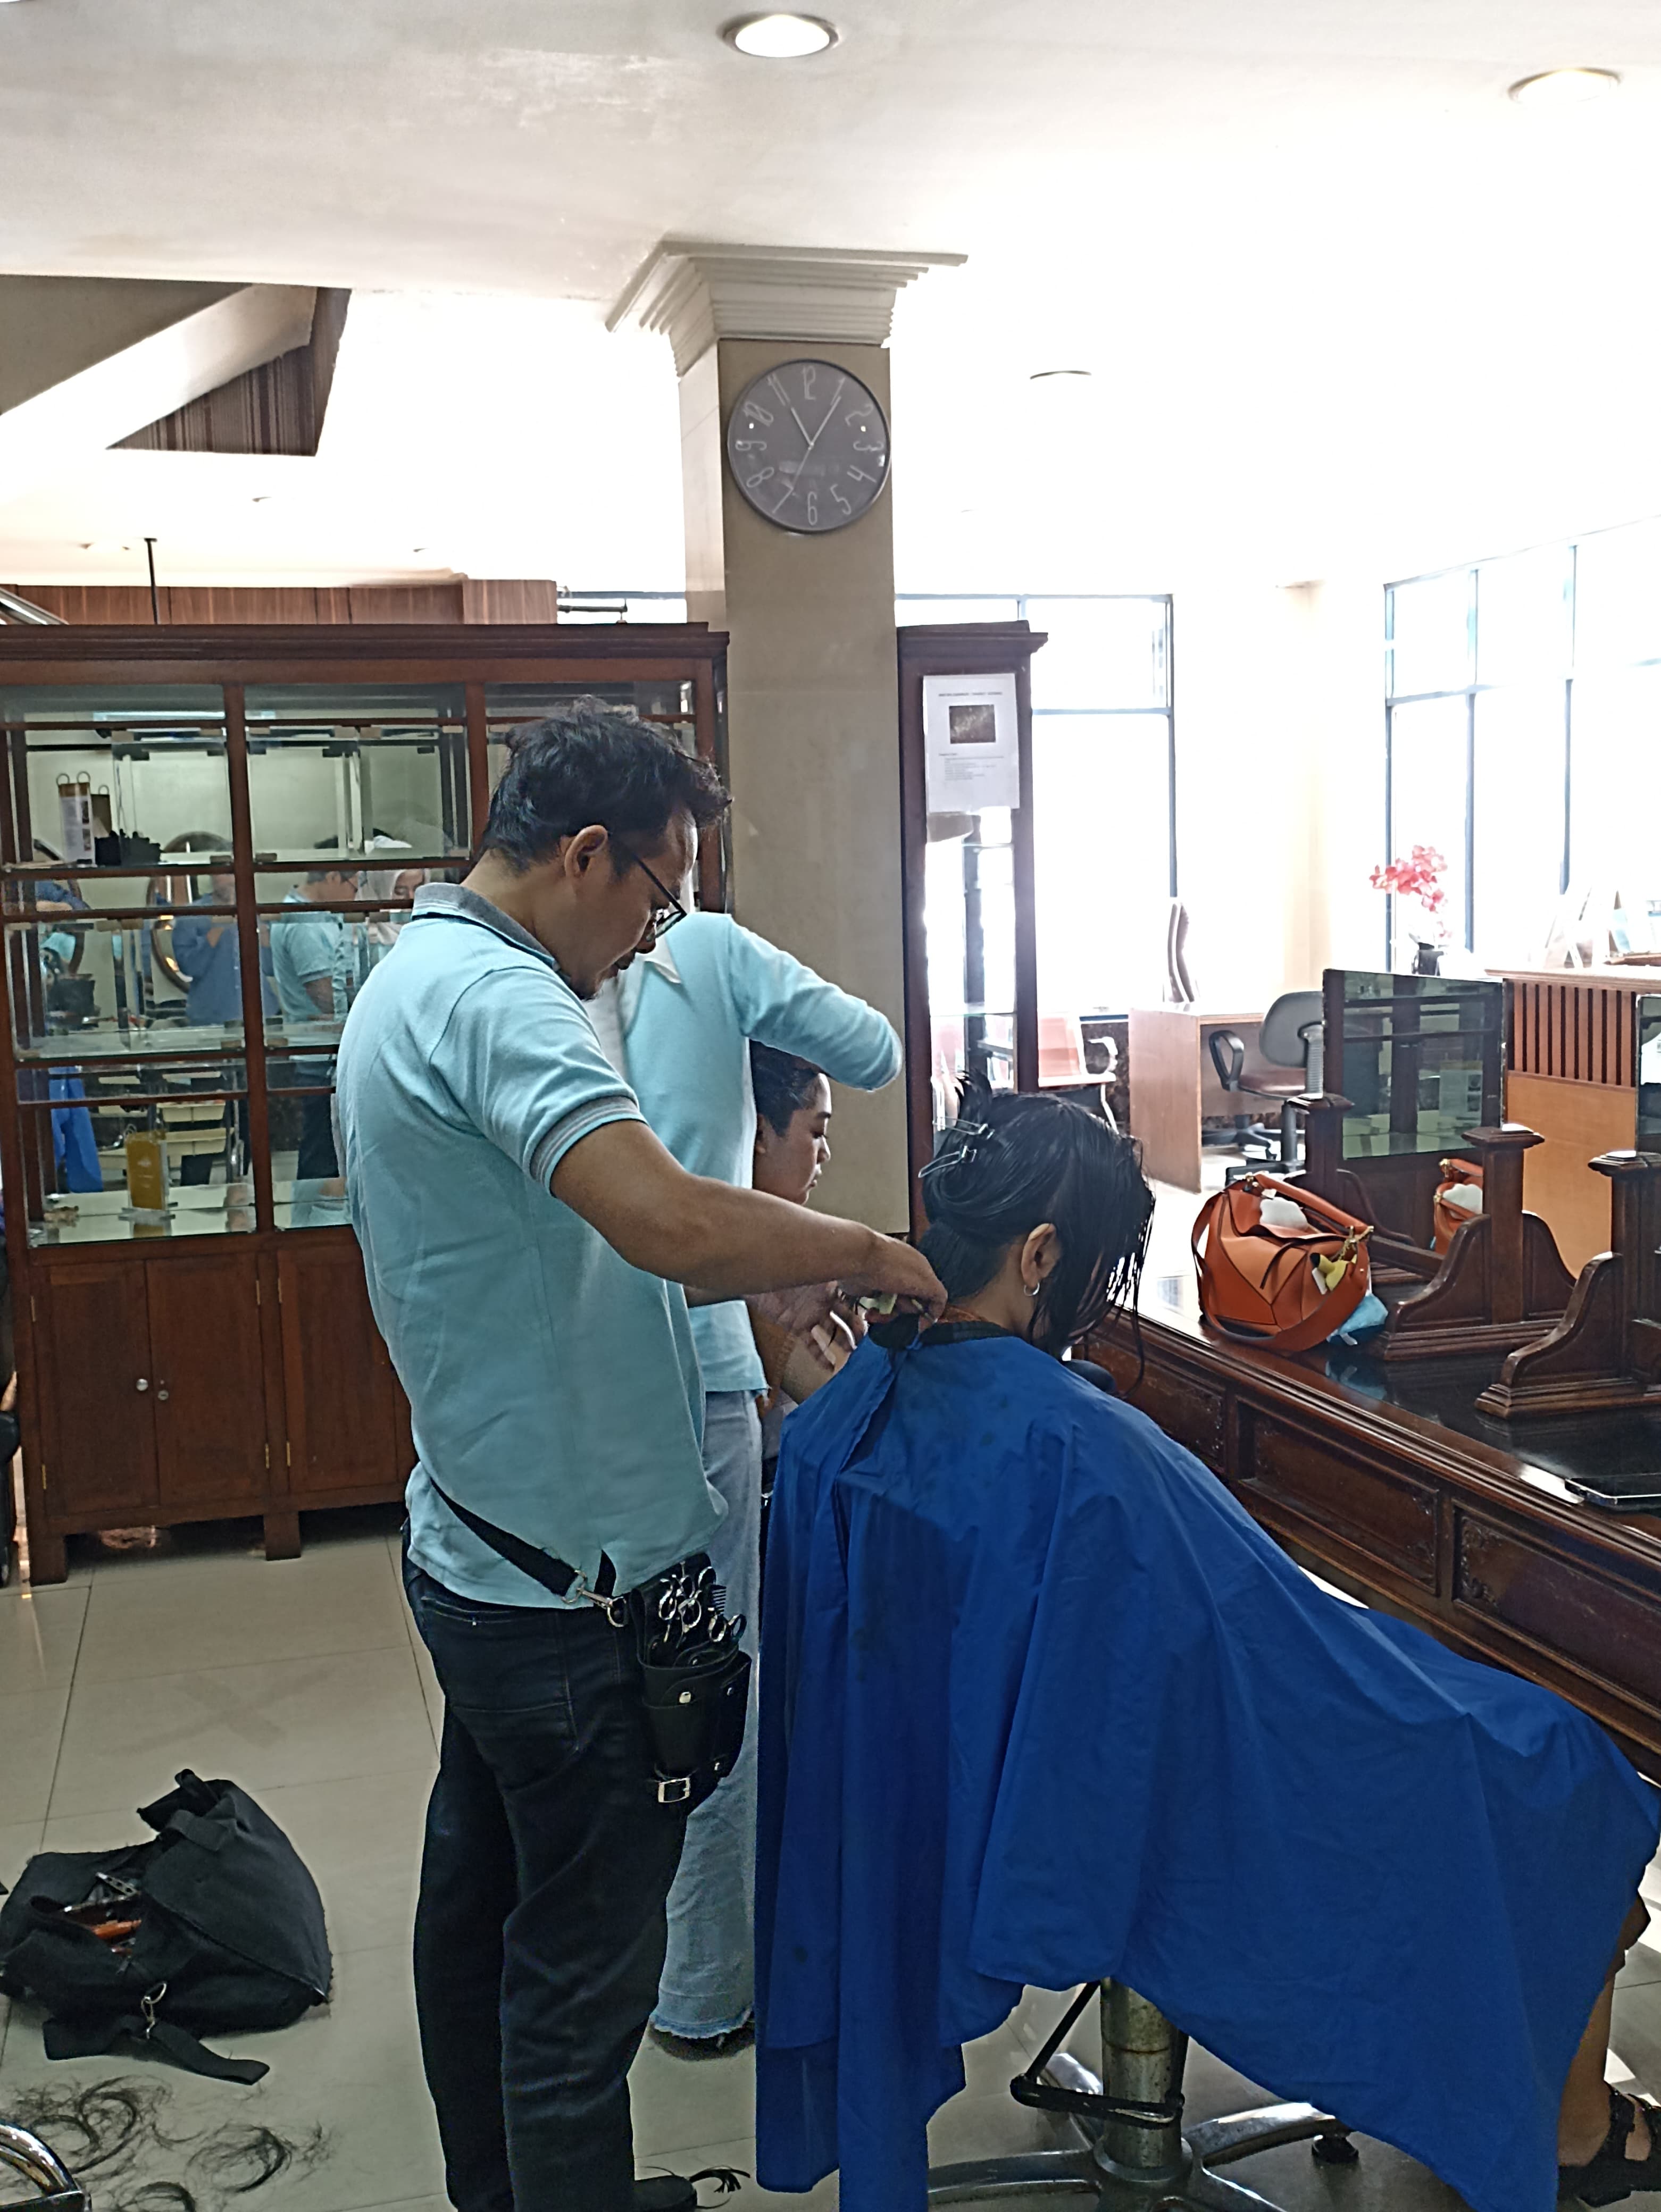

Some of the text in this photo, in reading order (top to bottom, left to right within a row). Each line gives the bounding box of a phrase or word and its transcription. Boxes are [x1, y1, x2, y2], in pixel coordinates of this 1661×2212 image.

[767, 373, 791, 406] 11
[803, 365, 817, 400] 12
[830, 377, 846, 406] 1
[743, 401, 774, 426] 10
[845, 403, 874, 426] 2
[735, 440, 767, 451] 9
[853, 440, 884, 452] 3
[746, 467, 774, 488] 8
[847, 465, 877, 483] 4
[773, 480, 794, 514] 7
[807, 491, 818, 525] 6
[830, 483, 852, 515] 5
